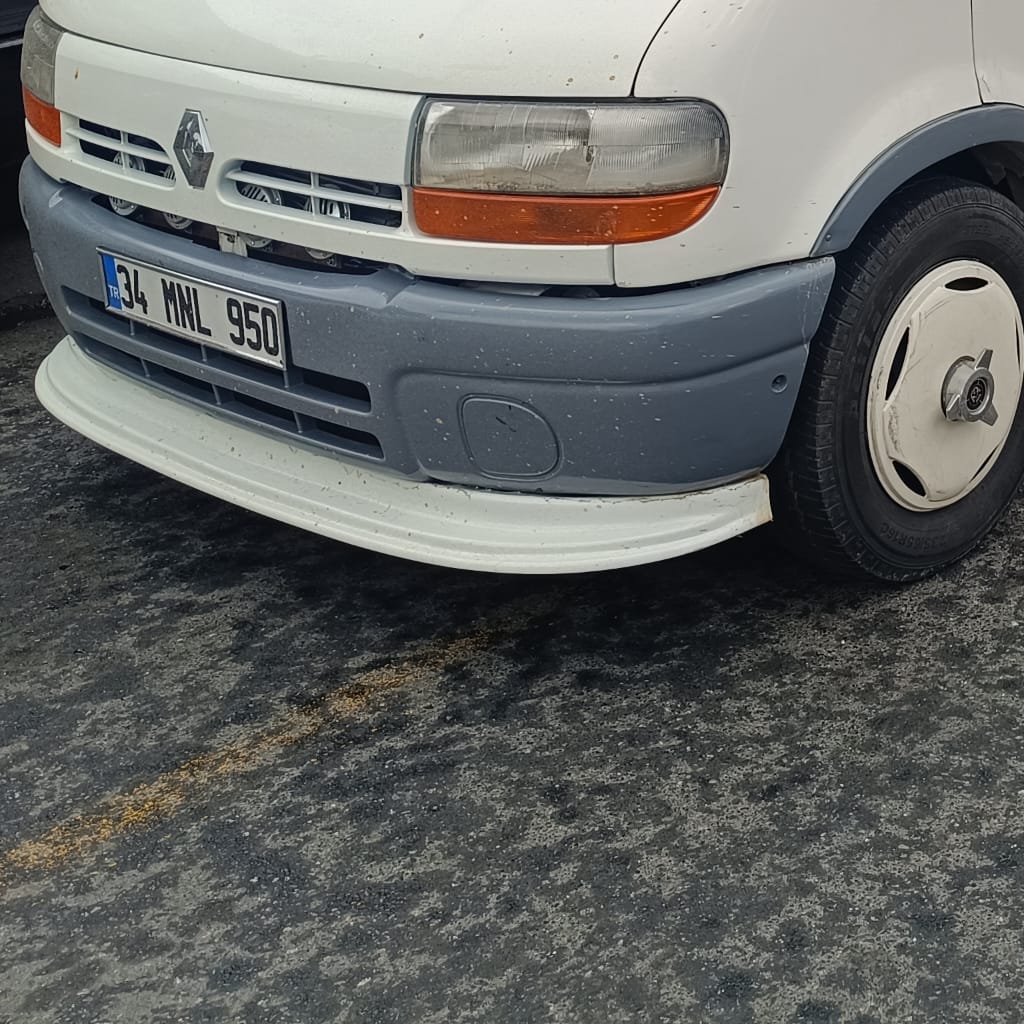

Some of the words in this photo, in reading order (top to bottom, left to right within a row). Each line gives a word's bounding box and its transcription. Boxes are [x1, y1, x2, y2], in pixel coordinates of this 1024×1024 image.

[108, 284, 120, 301] TR
[117, 264, 149, 315] 34
[161, 278, 212, 337] MNL
[226, 297, 279, 357] 950
